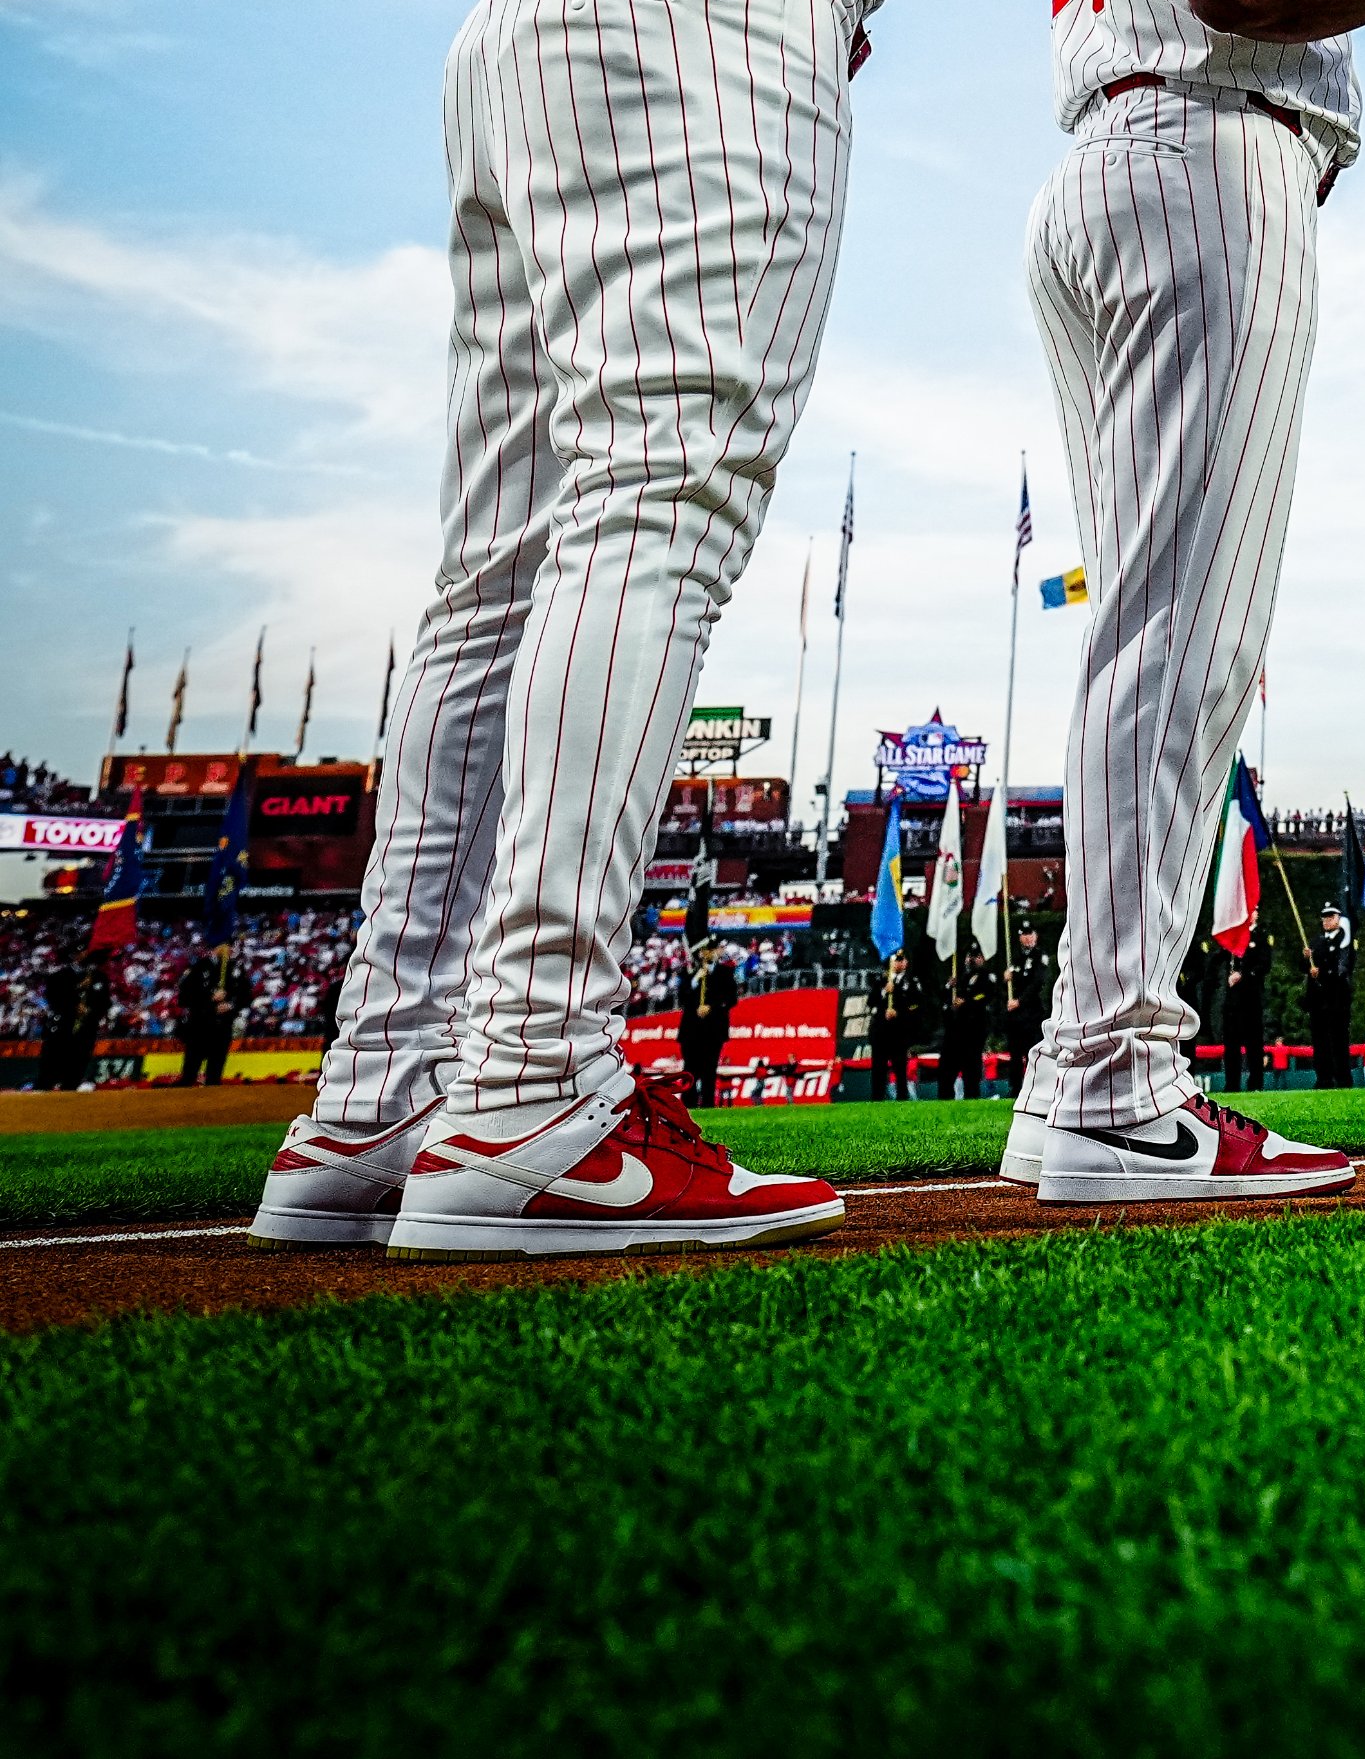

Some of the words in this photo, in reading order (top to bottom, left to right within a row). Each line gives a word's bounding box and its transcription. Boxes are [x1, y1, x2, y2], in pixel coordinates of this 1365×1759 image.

[876, 744, 904, 765] ALL
[905, 744, 944, 765] STAR
[944, 743, 986, 765] GAME
[260, 795, 351, 817] GIANT
